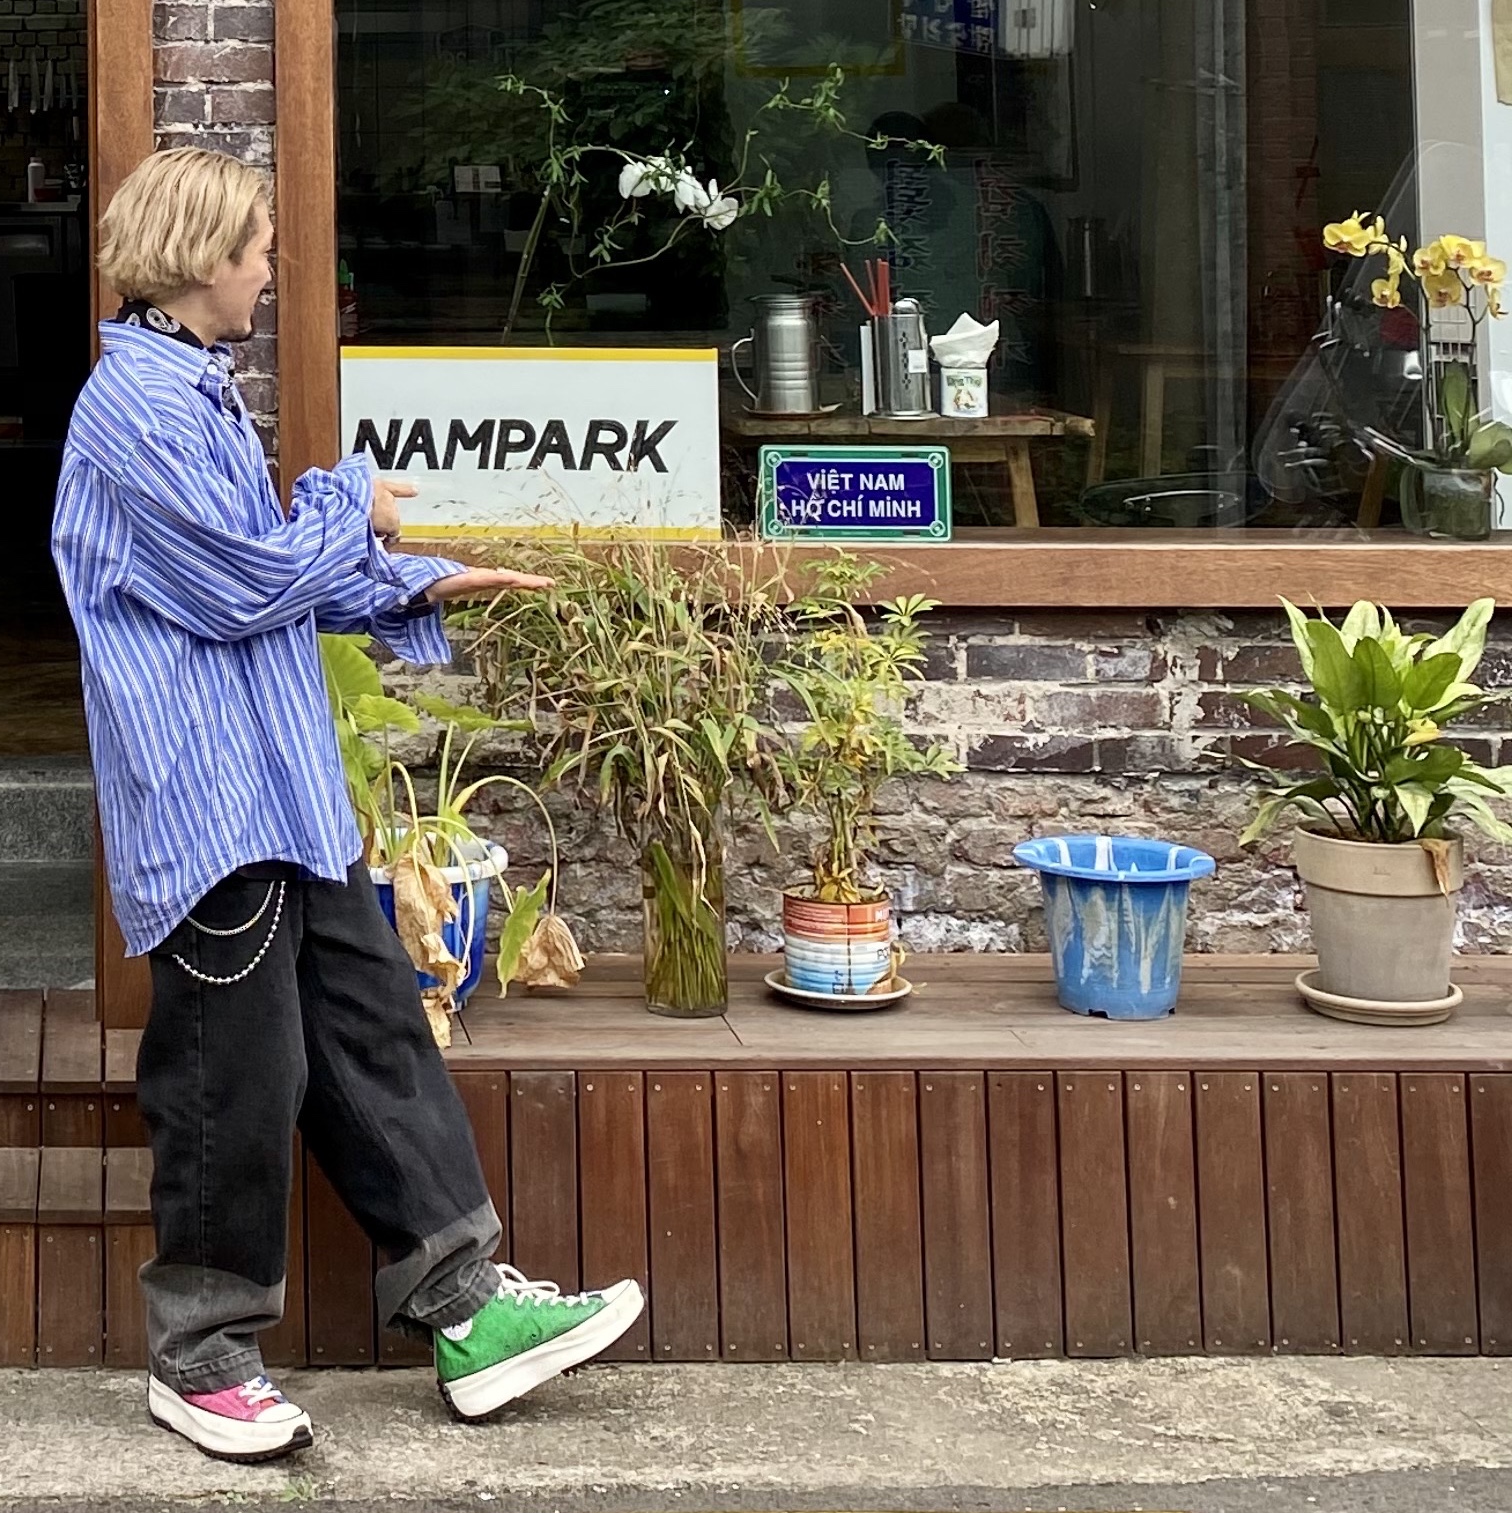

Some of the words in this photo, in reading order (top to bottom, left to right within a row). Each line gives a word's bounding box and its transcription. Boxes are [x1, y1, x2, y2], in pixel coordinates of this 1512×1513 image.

[352, 418, 679, 473] NAMPARK
[859, 473, 905, 491] NAM
[827, 494, 864, 518] CHÍ
